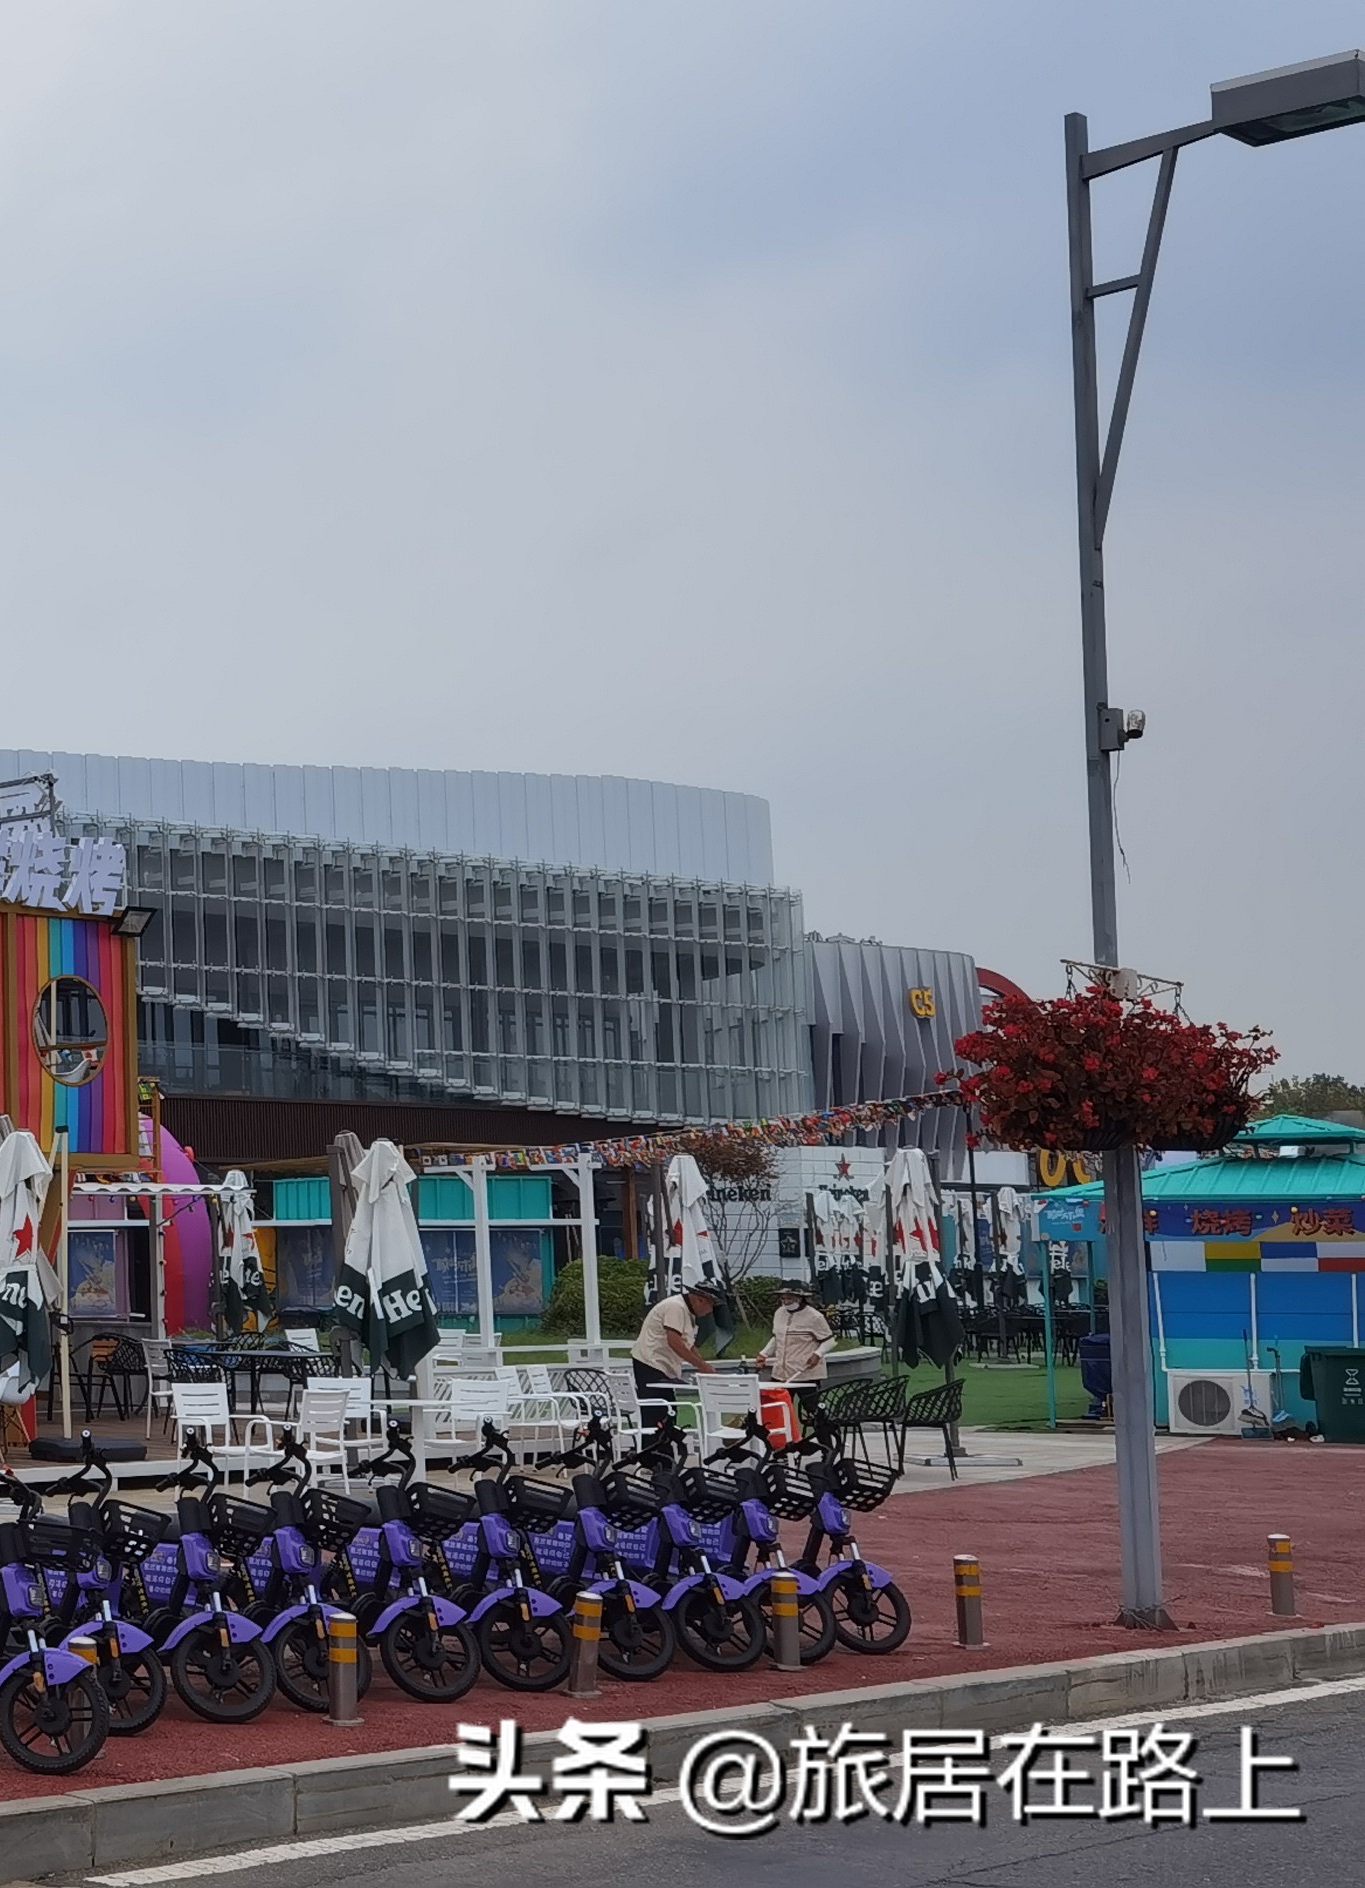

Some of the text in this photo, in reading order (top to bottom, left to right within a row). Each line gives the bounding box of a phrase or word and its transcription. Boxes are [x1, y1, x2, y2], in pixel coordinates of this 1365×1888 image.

[911, 989, 936, 1016] C5
[1191, 1209, 1253, 1236] 烧烤
[1291, 1209, 1356, 1236] 炒菜
